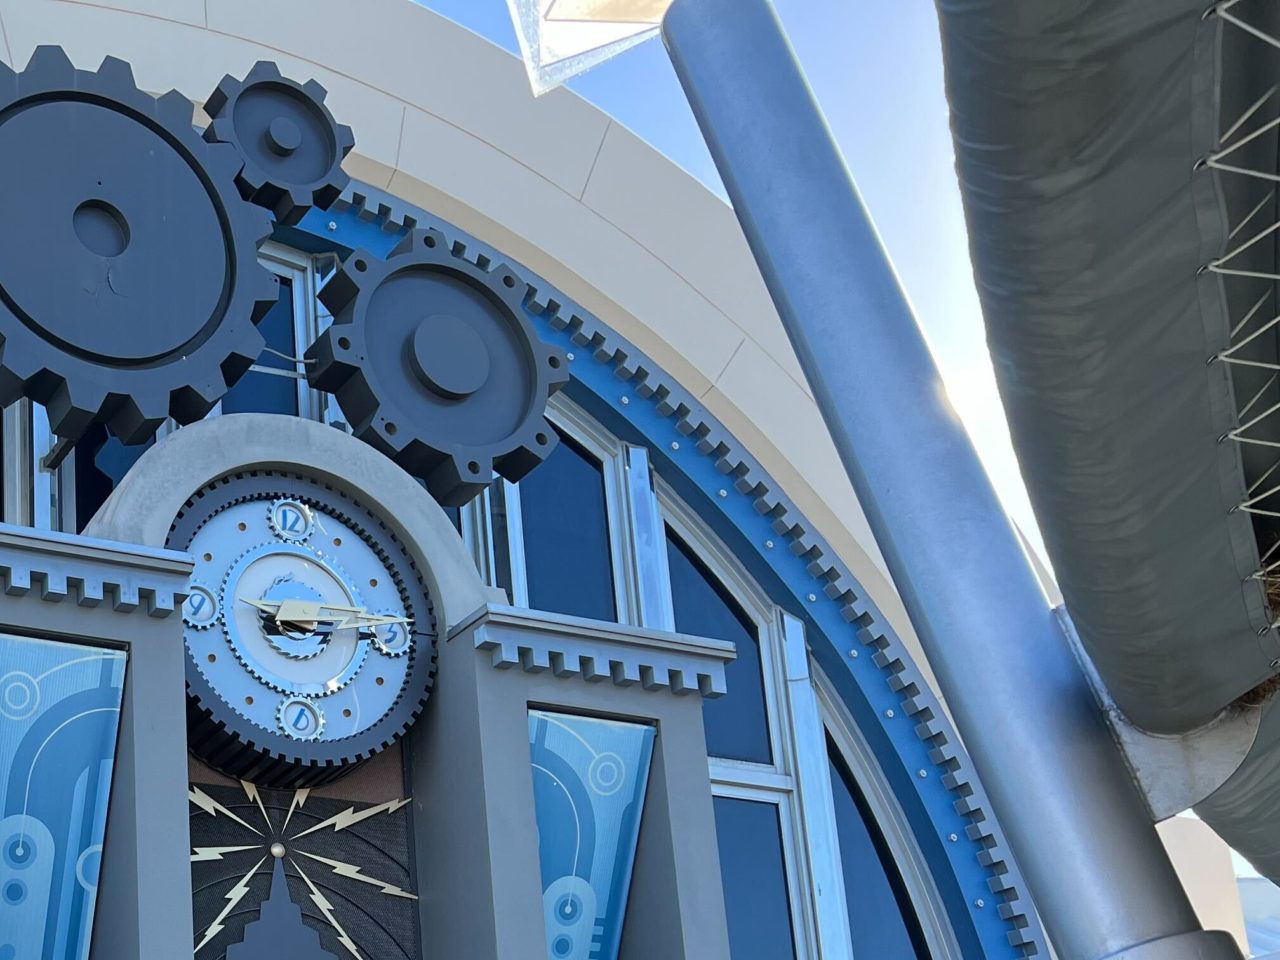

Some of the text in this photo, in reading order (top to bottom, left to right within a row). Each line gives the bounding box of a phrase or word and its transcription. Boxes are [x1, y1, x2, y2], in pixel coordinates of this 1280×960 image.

[282, 508, 301, 533] 12
[189, 592, 206, 616] 9
[292, 707, 310, 731] 6
